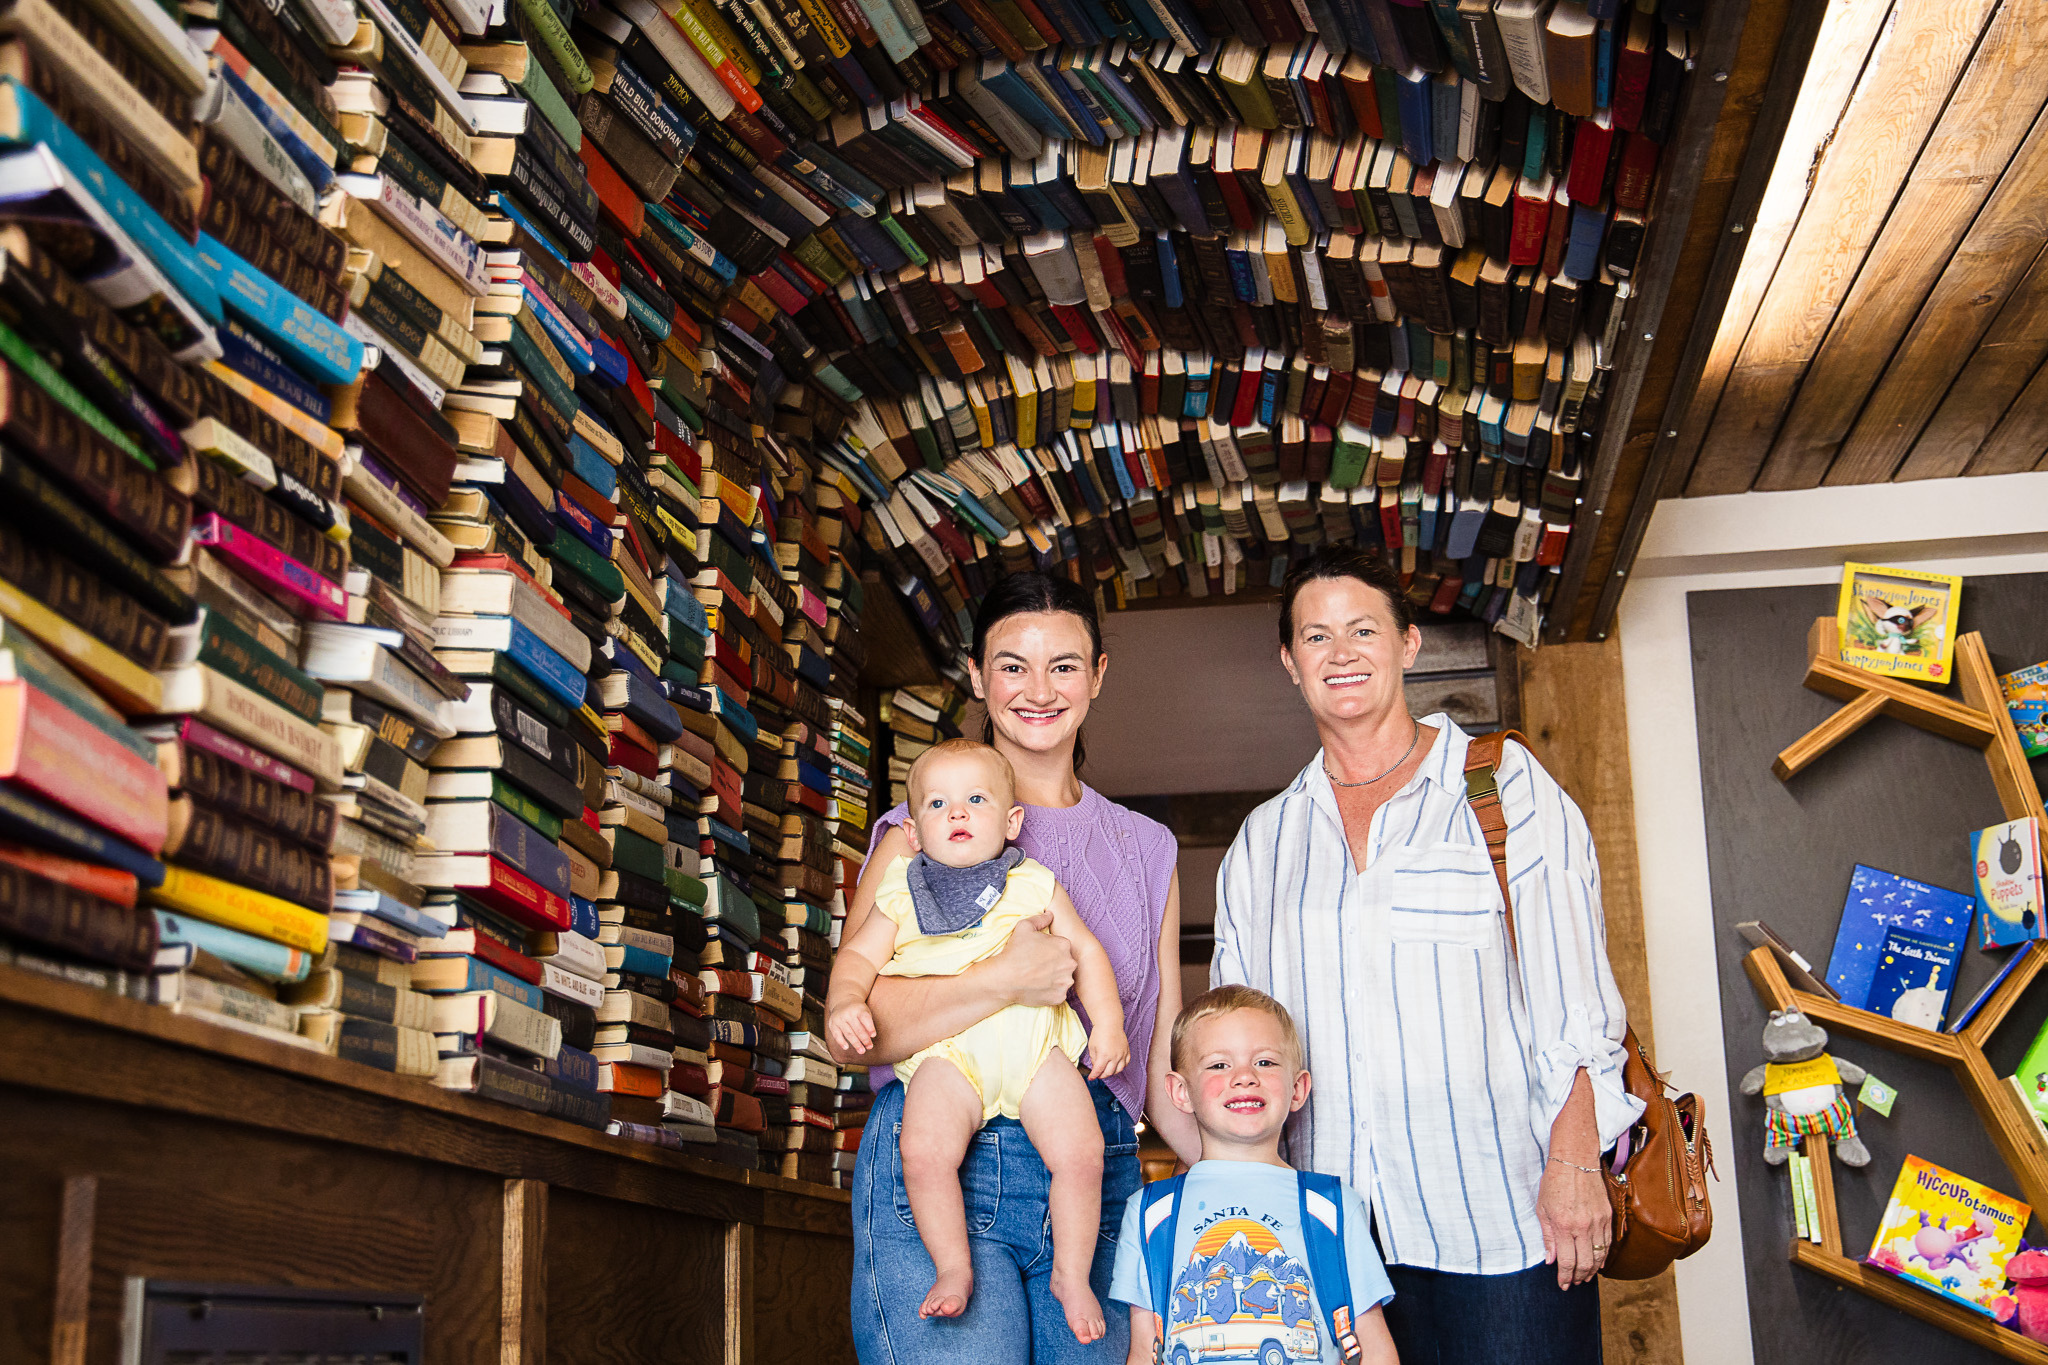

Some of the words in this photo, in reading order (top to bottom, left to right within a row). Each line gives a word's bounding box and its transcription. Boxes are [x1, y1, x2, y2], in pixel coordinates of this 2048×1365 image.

[399, 6, 422, 35] BOOK
[725, 0, 748, 23] Writing
[741, 17, 756, 33] with
[750, 33, 772, 56] Purpose
[680, 11, 695, 26] WIN
[688, 21, 702, 35] THE
[696, 31, 712, 47] WAR
[704, 42, 725, 63] WITHIN
[828, 27, 848, 50] Knitting
[664, 72, 693, 103] NORMAL
[612, 74, 635, 97] WILD
[631, 93, 652, 115] BILL
[648, 111, 683, 147] DONOVAN
[382, 142, 416, 173] WORLD
[414, 170, 442, 196] BOOK
[511, 163, 533, 186] AND
[524, 178, 563, 220] CONQUEST
[557, 212, 573, 227] OF
[565, 220, 596, 253] MEXICO
[380, 271, 415, 301] WORLD
[413, 297, 441, 322] BOOK
[365, 294, 401, 325] WORLD
[396, 319, 426, 346] BOOK
[300, 393, 327, 416] THE
[1908, 587, 1941, 607] Jones
[448, 628, 472, 636] LIBRARY
[1888, 655, 1924, 675] Jones
[373, 710, 417, 750] LIVING
[1991, 884, 2024, 903] Puppets
[1886, 940, 1902, 953] The
[1900, 944, 1923, 959] Little
[1923, 950, 1951, 966] Prince
[1916, 1169, 2015, 1226] HICCUPotamus
[1193, 1206, 1249, 1235] SANTA
[1261, 1213, 1283, 1232] FE
